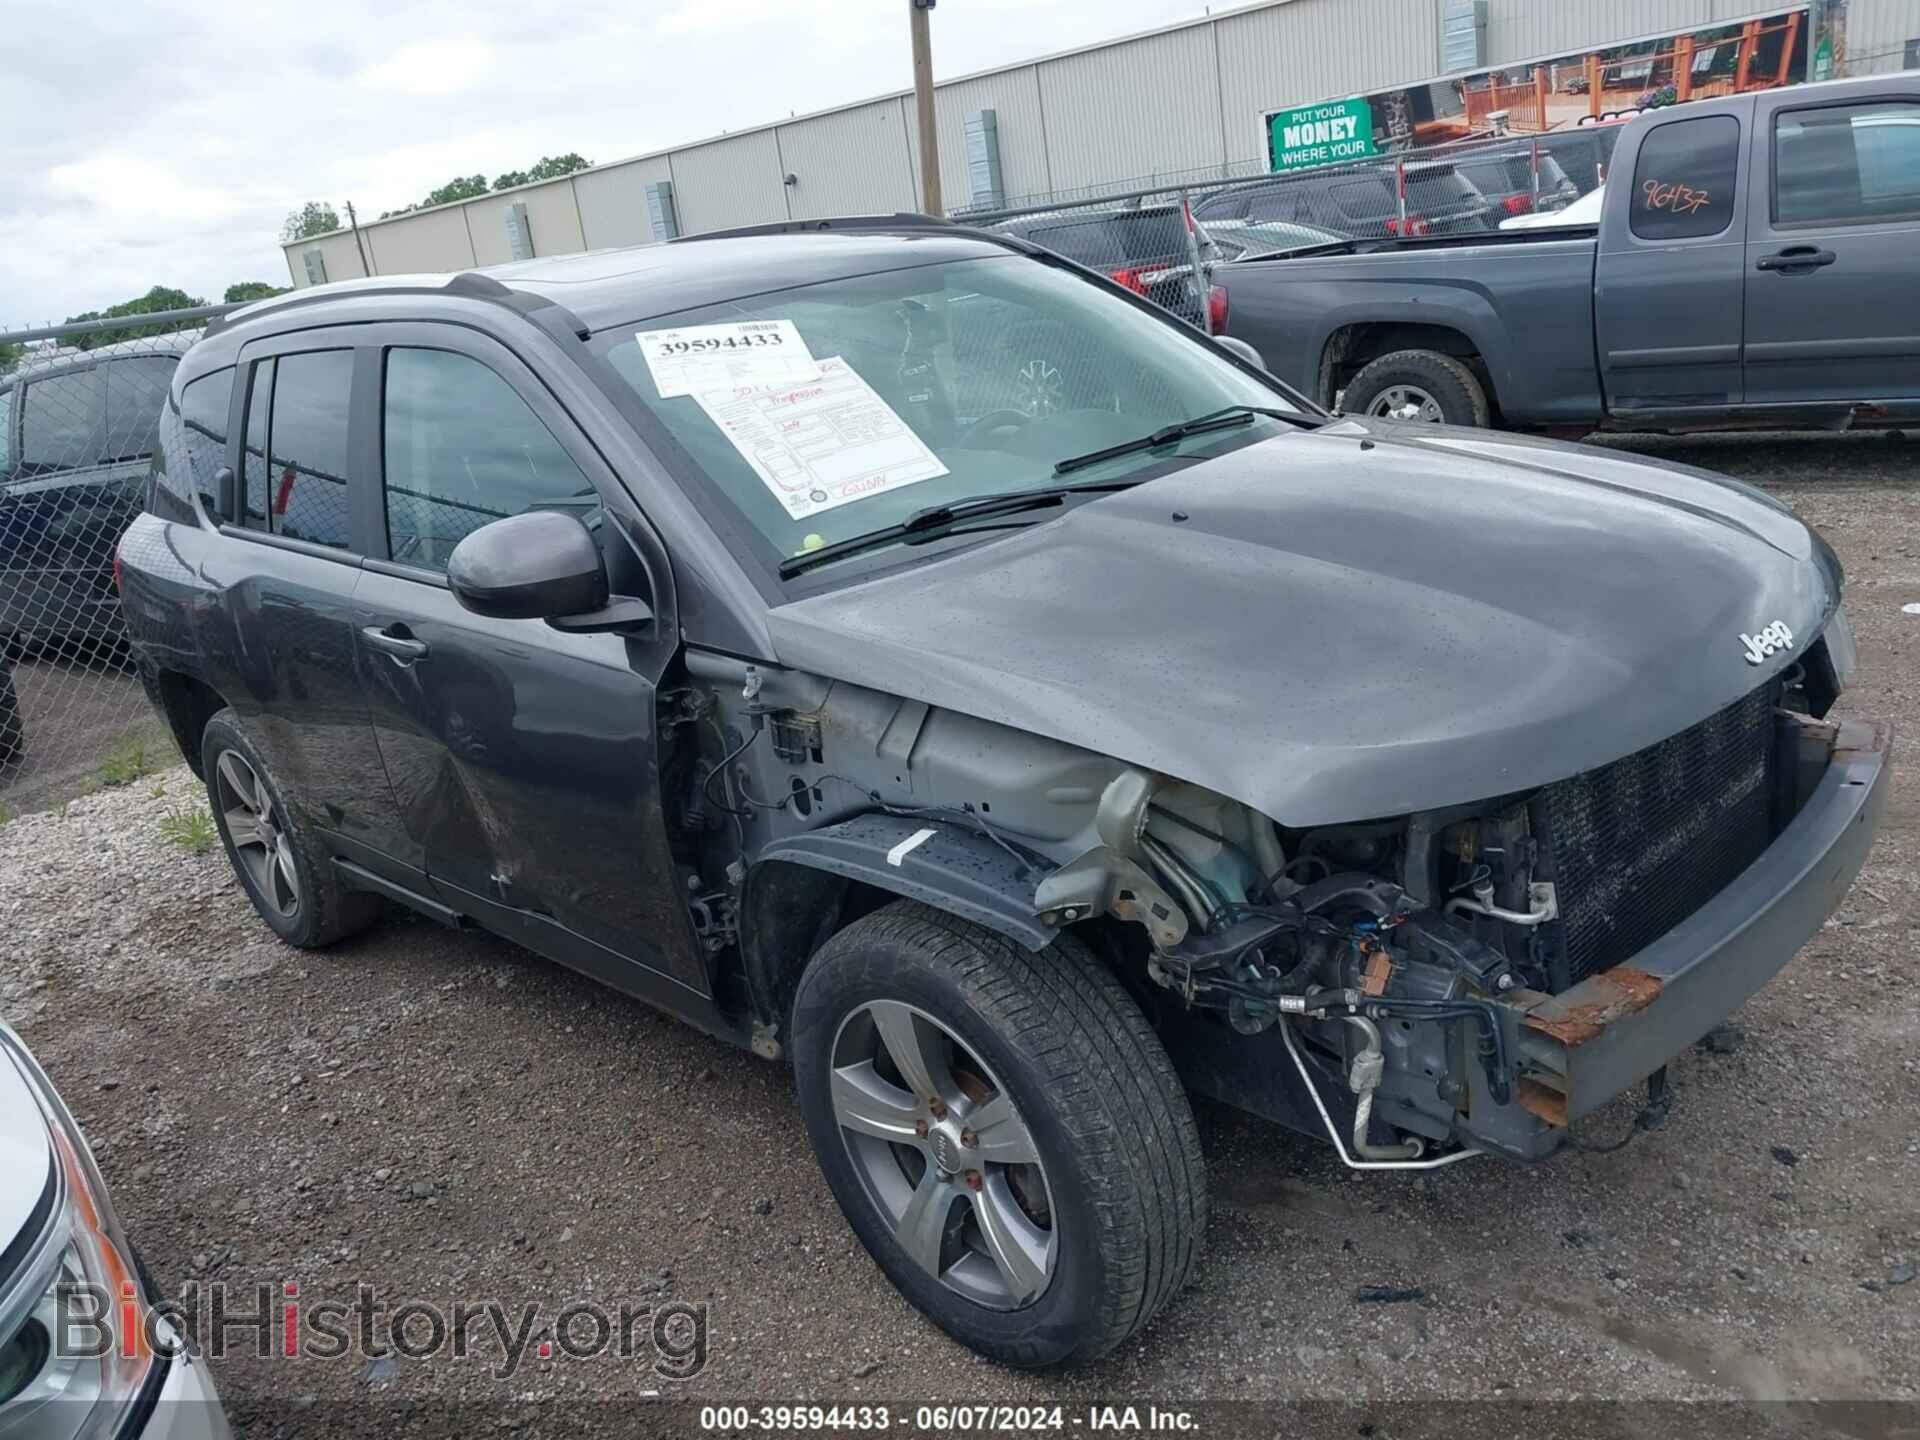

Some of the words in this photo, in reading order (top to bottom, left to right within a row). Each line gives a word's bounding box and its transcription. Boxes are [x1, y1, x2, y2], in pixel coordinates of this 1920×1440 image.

[1292, 110, 1314, 123] PUT
[1314, 105, 1345, 119] YOUR
[1283, 115, 1358, 149] MONEY
[1281, 147, 1328, 165] WHERE
[1330, 140, 1365, 157] YOUR
[659, 333, 784, 357] 39594433
[1737, 619, 1794, 664] Jeep
